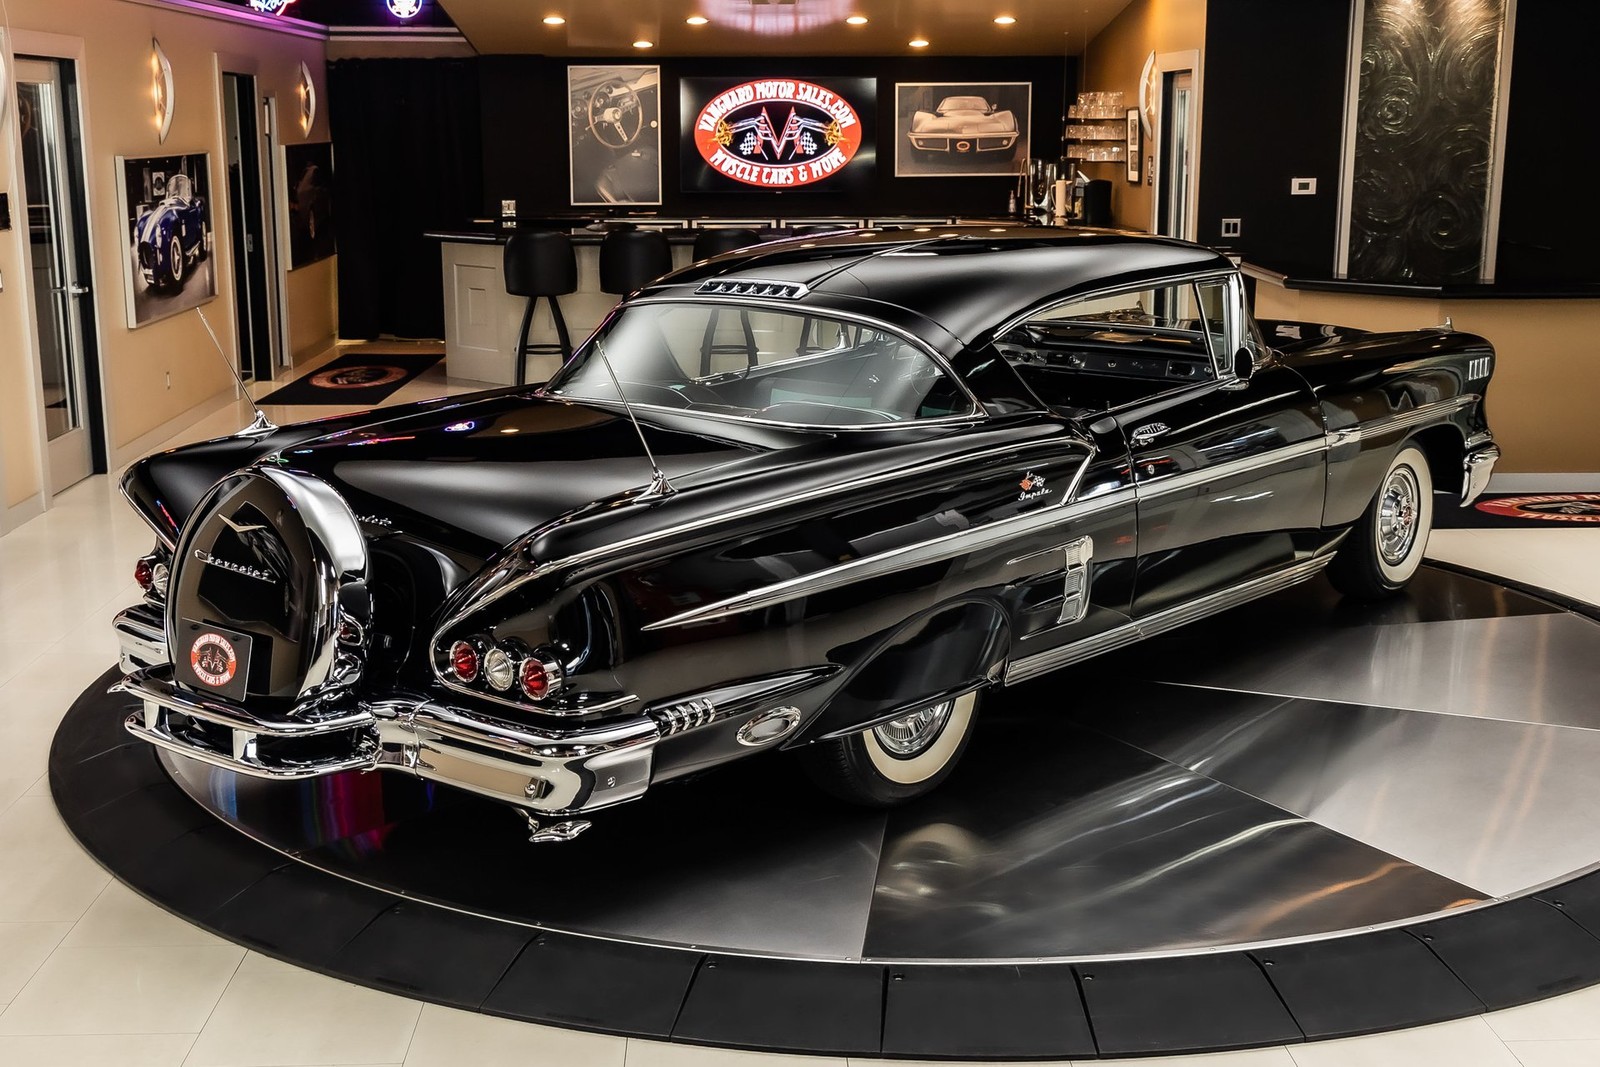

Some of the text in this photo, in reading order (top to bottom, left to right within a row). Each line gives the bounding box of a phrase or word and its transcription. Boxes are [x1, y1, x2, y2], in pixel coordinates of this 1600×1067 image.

[698, 81, 857, 132] VANGUARD MOTOR SALES.COM
[709, 147, 848, 185] MUSCLE CARS & MORE
[1018, 488, 1053, 501] Impala
[194, 549, 276, 584] Chevrolet
